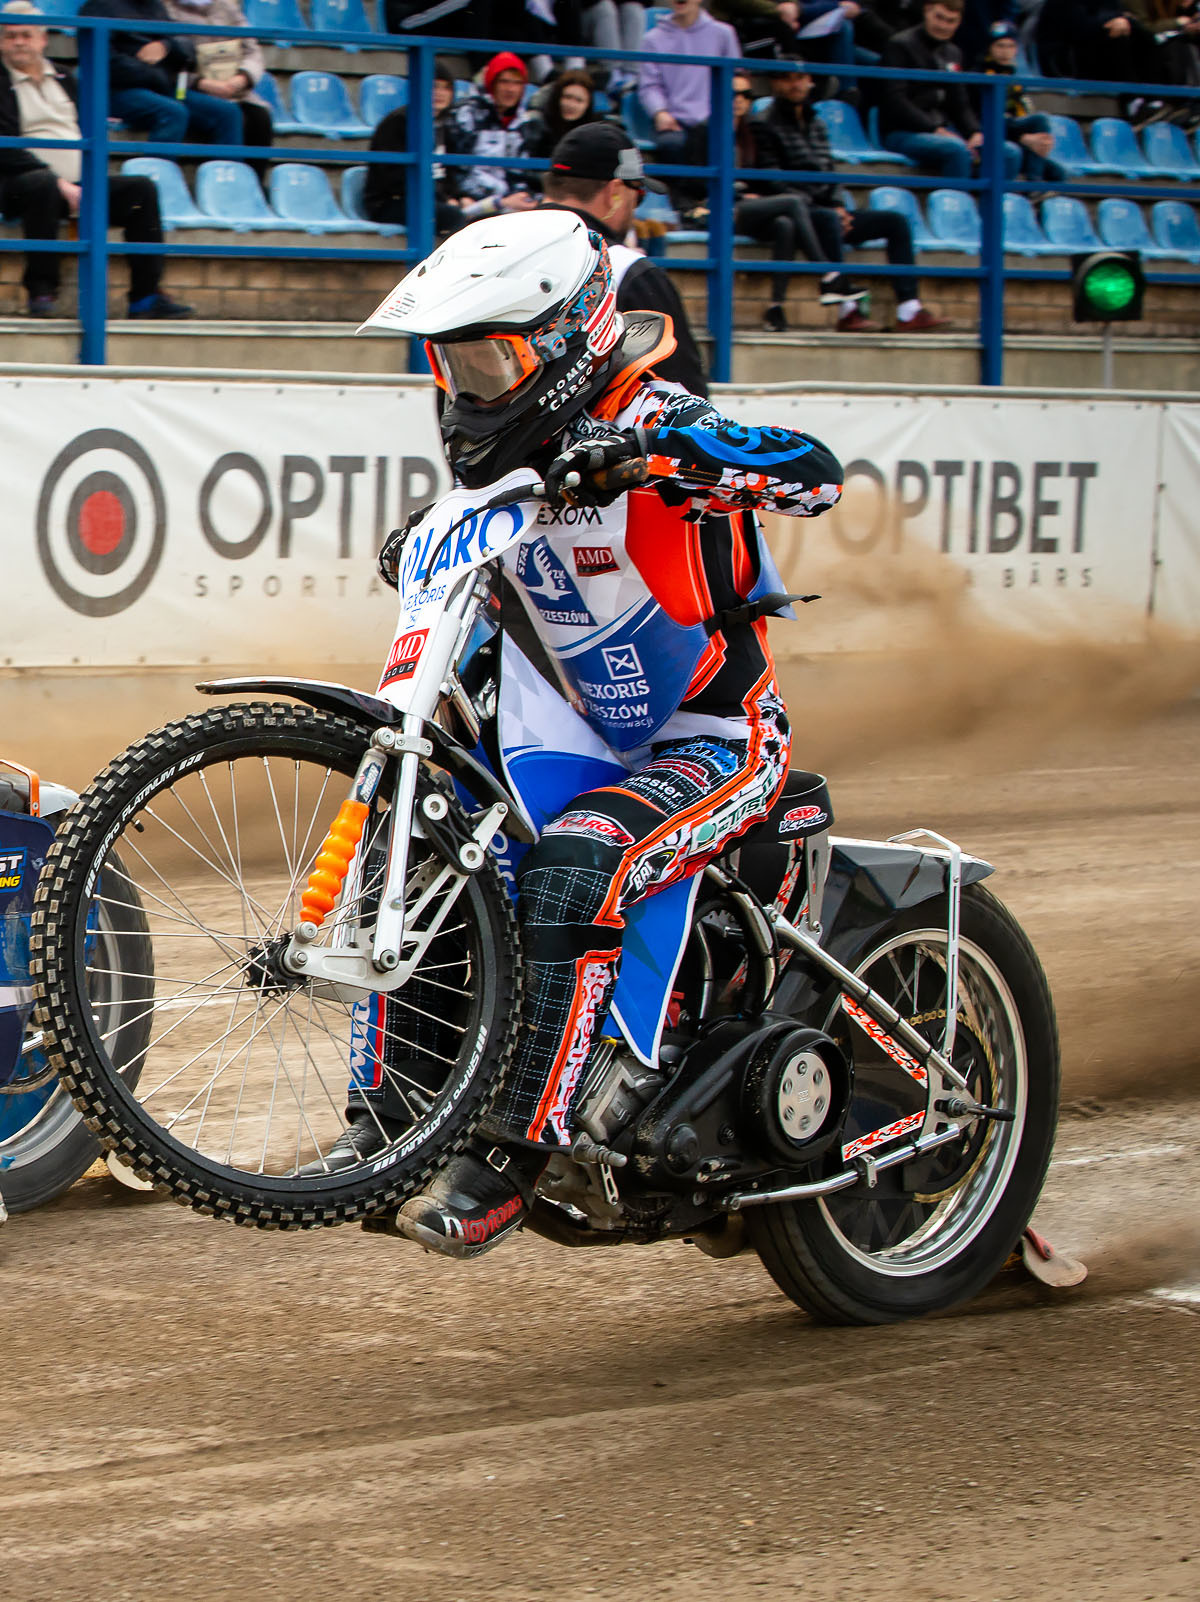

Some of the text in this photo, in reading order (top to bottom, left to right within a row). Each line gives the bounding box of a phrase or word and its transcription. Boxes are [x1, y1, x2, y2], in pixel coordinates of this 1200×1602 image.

[538, 350, 593, 406] PROMET
[550, 365, 593, 411] CARGO
[537, 503, 603, 526] EXOM
[576, 550, 612, 565] AMD
